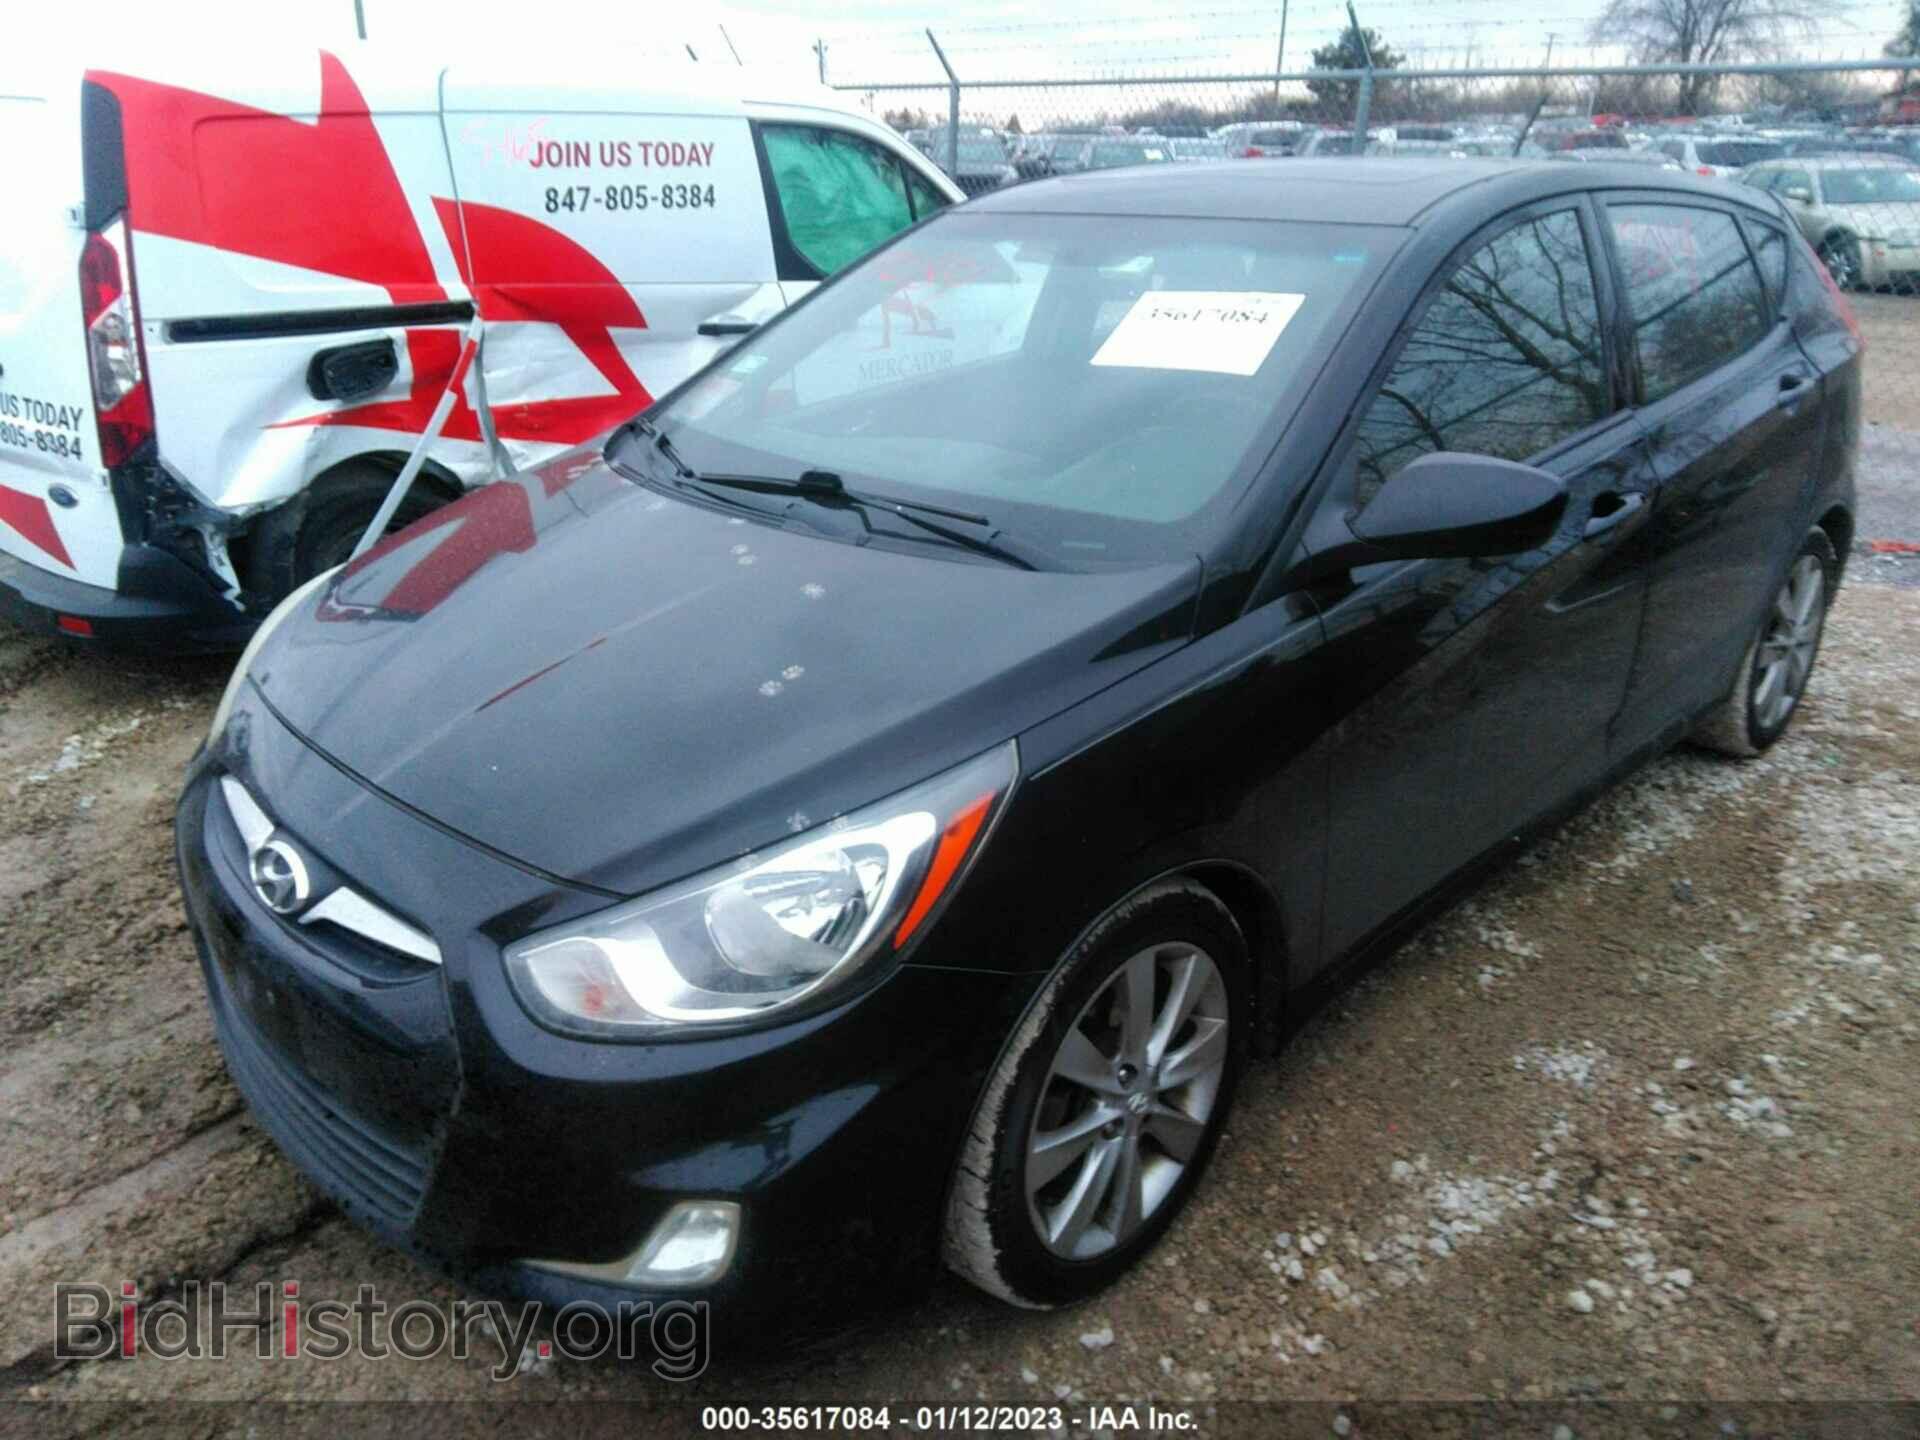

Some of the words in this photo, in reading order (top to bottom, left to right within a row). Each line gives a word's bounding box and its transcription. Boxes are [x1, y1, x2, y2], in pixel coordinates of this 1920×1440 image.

[529, 141, 591, 168] JOIN
[599, 142, 632, 167] US
[638, 142, 714, 167] TODAY
[544, 184, 716, 213] 847-805-8384
[0, 392, 19, 418] US
[22, 397, 83, 431] TODAY
